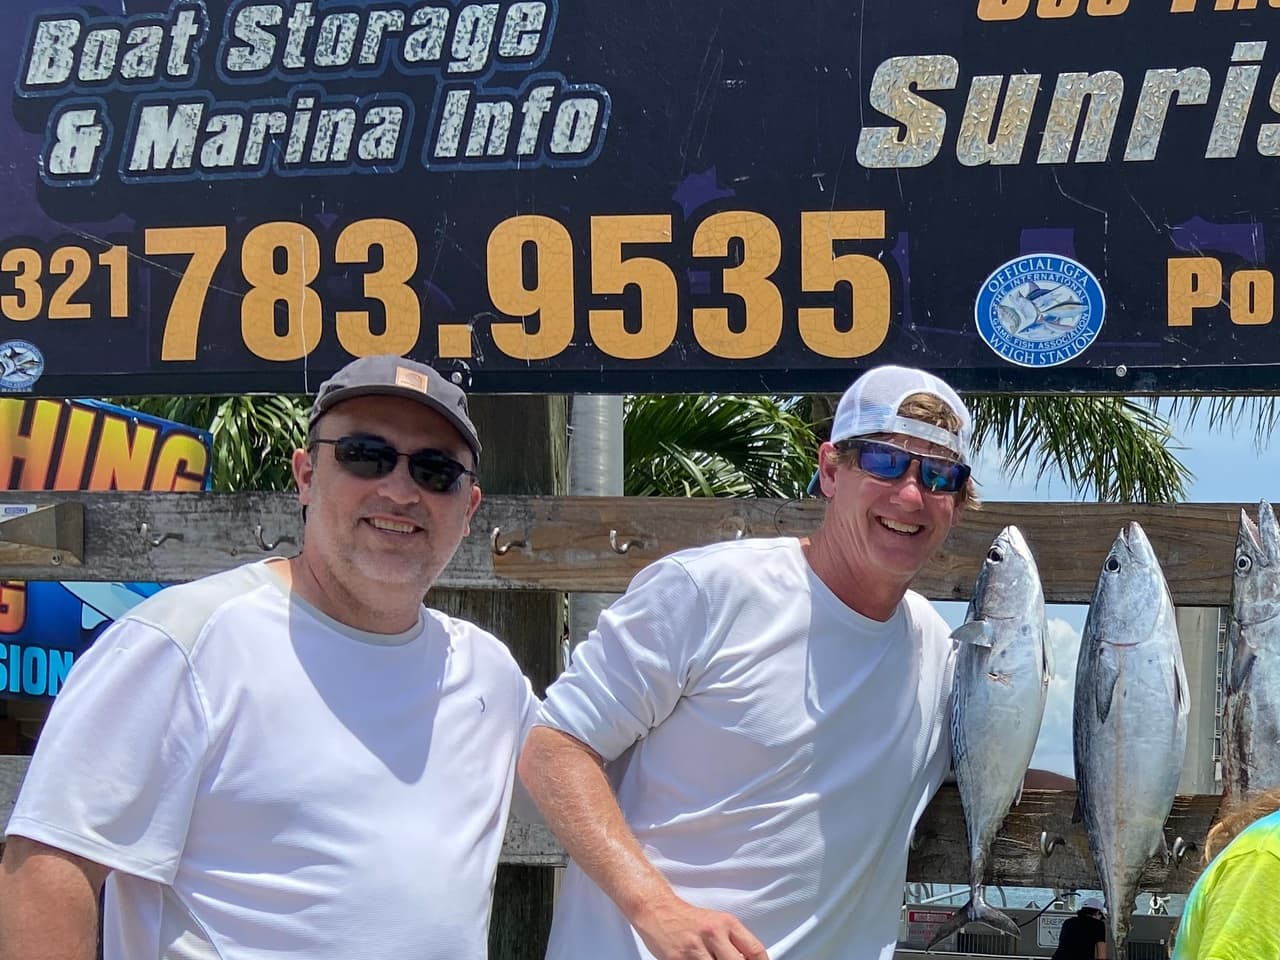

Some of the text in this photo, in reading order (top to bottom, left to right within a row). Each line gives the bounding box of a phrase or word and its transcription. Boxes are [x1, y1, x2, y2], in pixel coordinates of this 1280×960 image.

[26, 1, 545, 86] Boat Storage
[50, 83, 600, 175] & Marina Info
[0, 210, 893, 362] 321 783.9535
[988, 258, 1089, 293] OFFICIAL IGFA
[993, 273, 1086, 307] THE INTERNATIONAL
[988, 327, 1095, 365] WEIGH STATION
[993, 313, 1089, 349] GAME FISH ASSOCIATION
